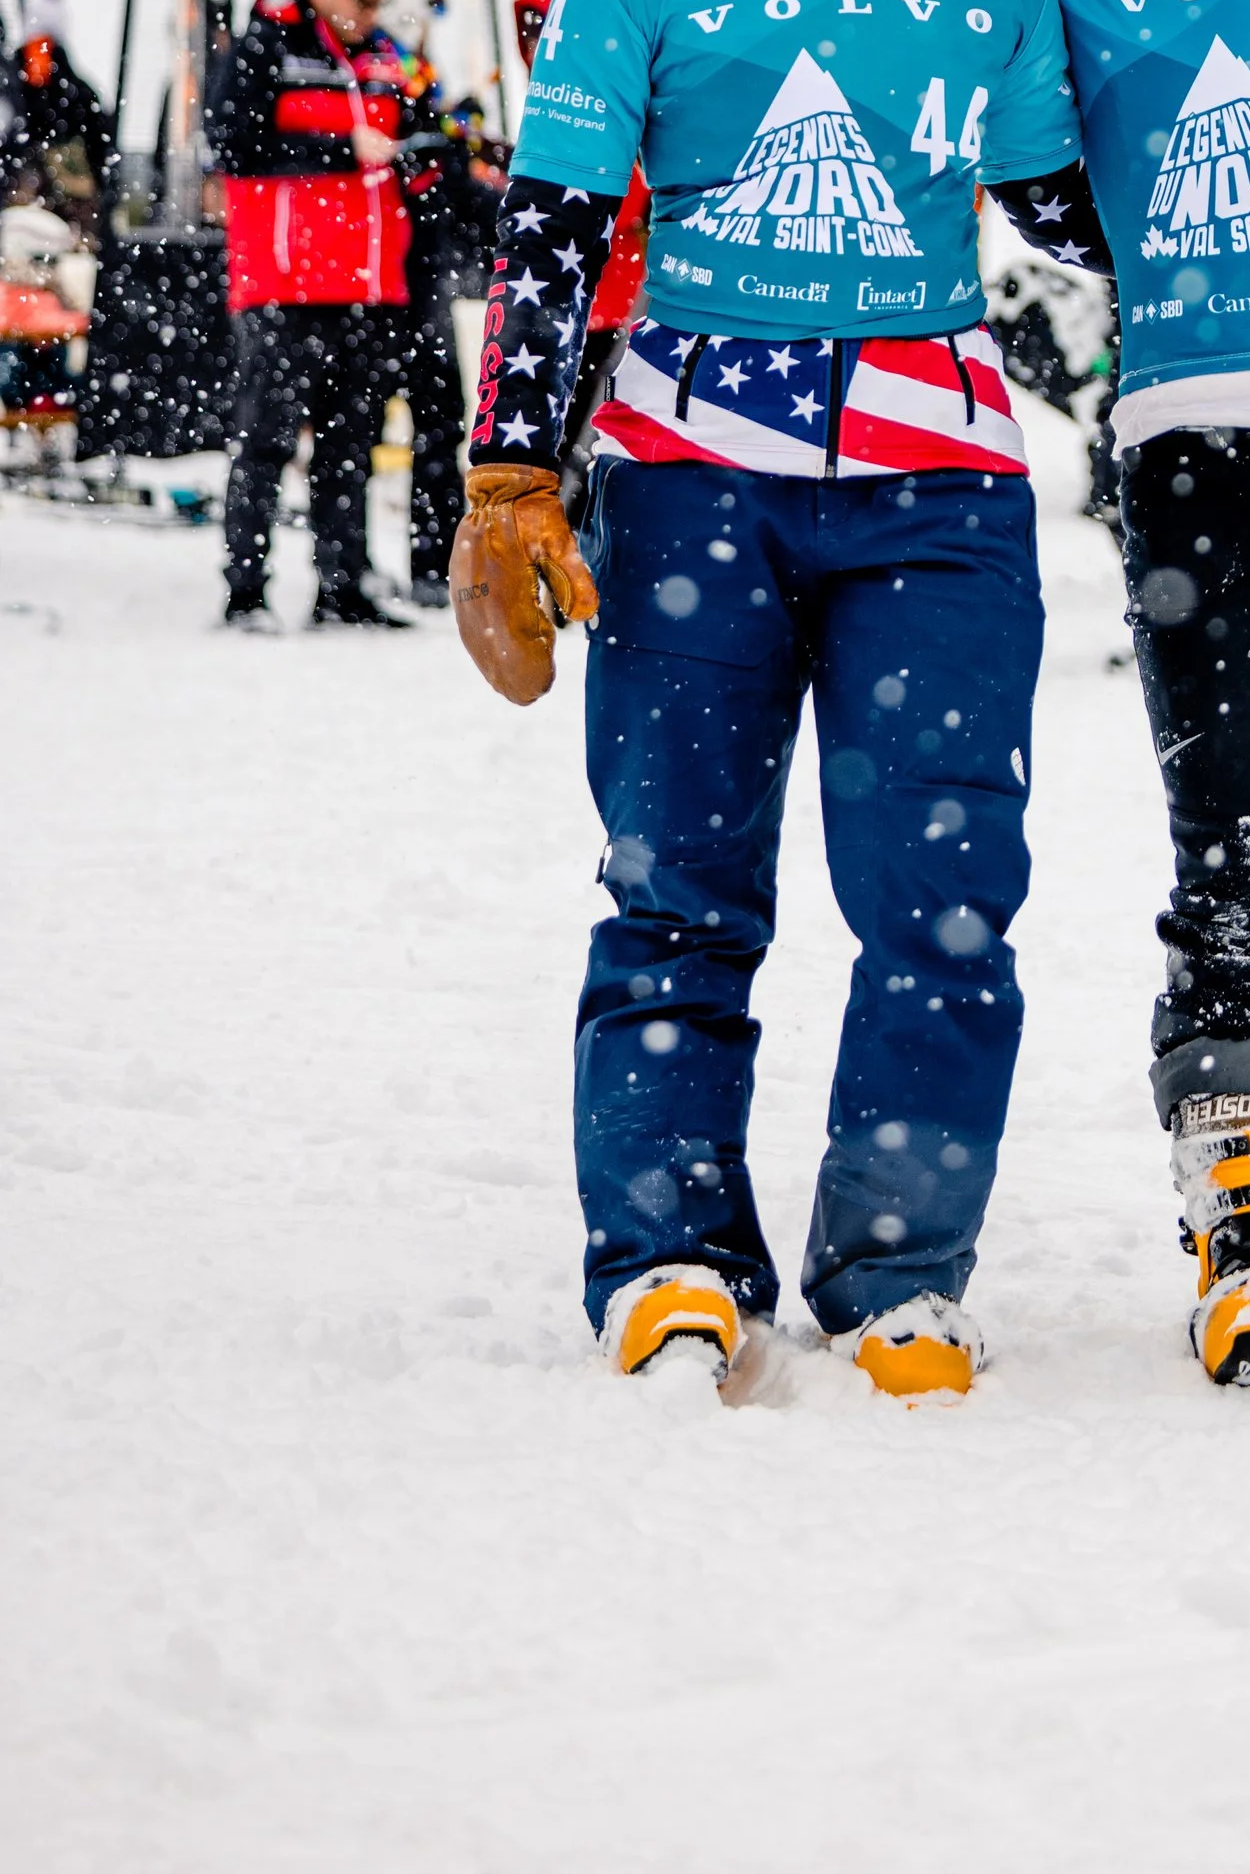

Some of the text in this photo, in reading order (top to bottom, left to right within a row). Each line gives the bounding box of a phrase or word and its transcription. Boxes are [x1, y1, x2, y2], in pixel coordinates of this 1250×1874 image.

[547, 107, 572, 123] Vivez
[573, 116, 606, 132] grand
[733, 112, 876, 182] LÉGENDES
[714, 158, 906, 227] NORD
[1146, 169, 1180, 219] DU
[714, 214, 925, 258] VAL SAINT-CÔME
[1180, 223, 1221, 259] VAL
[660, 252, 713, 286] CAN SBD
[737, 274, 831, 303] Canada
[1132, 298, 1184, 324] CAN SBD
